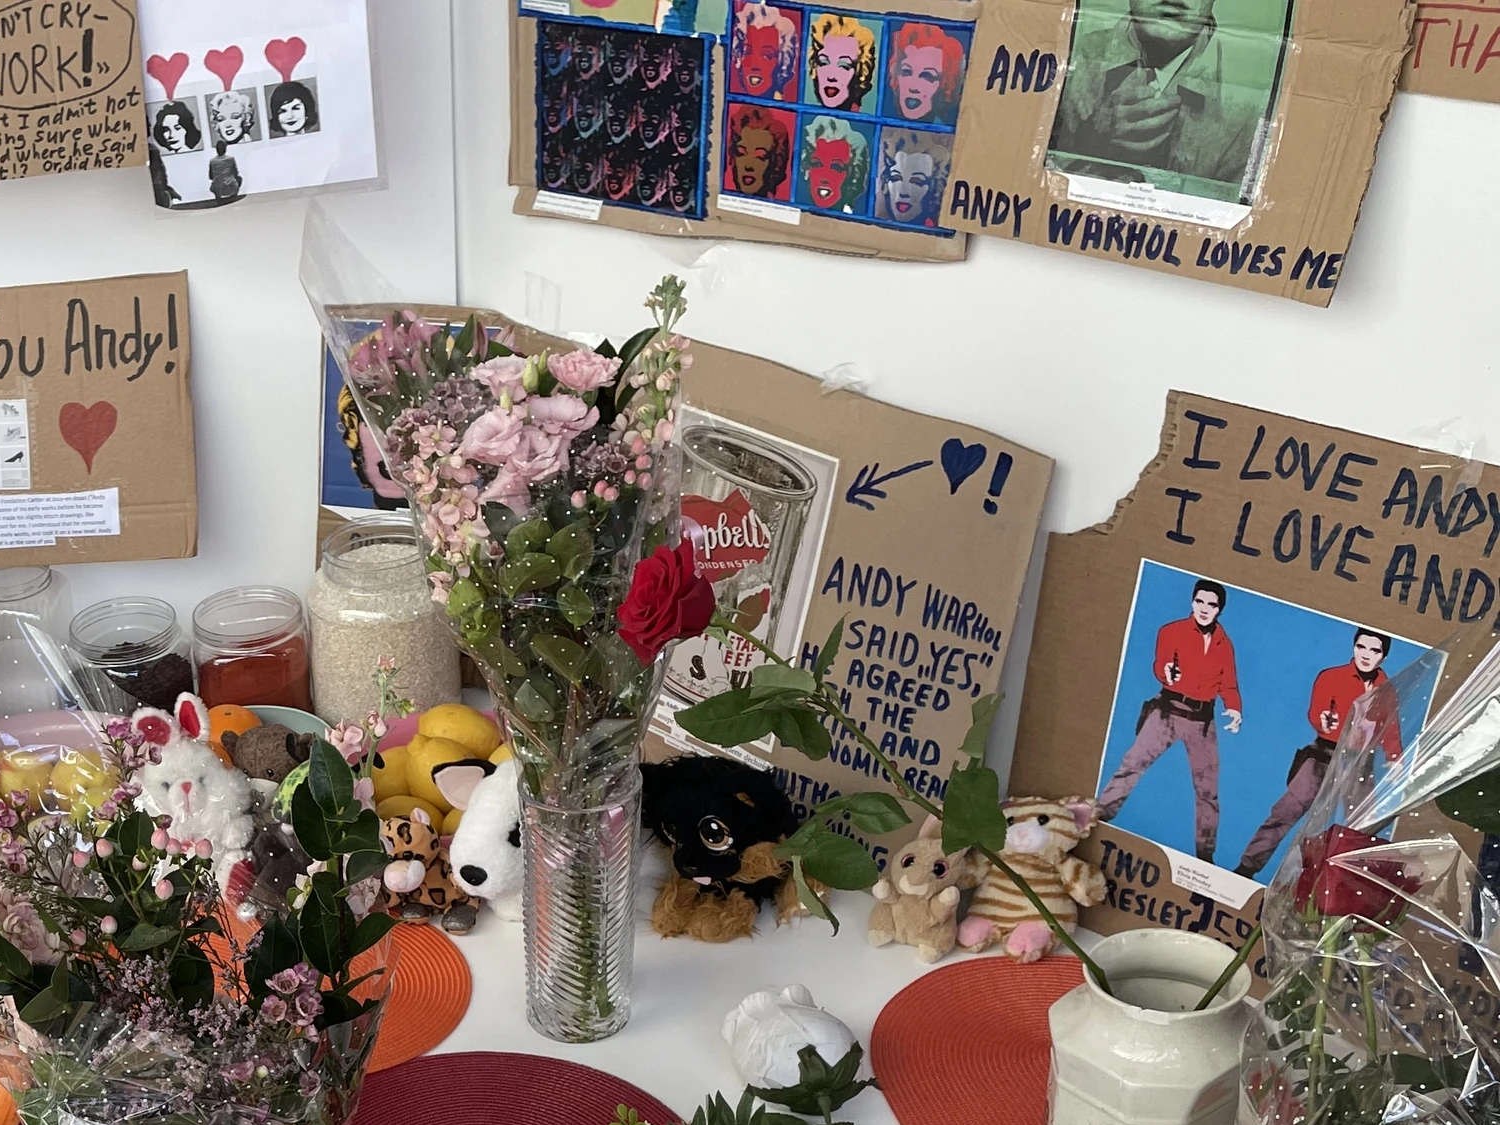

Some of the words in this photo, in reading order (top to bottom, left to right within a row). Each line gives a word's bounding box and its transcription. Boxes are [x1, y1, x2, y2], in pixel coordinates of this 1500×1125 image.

[987, 44, 1059, 95] AND
[17, 114, 30, 130] I
[37, 99, 97, 128] admit
[106, 85, 141, 113] not
[35, 127, 83, 143] sure
[88, 115, 131, 138] when
[16, 143, 66, 163] where
[73, 141, 94, 160] he
[99, 133, 138, 153] said
[93, 152, 125, 169] he?
[949, 180, 1031, 237] ANDY
[1048, 203, 1181, 267] WARHOL
[1196, 238, 1287, 276] LOVES
[1290, 246, 1343, 290] ME
[64, 293, 179, 382] Andy!
[1183, 409, 1228, 471] I
[1239, 424, 1378, 502] LOVE
[1382, 467, 1500, 558] ANDY
[1165, 487, 1202, 545] I
[1232, 501, 1375, 583] LOVE
[1382, 544, 1500, 626] AND
[822, 556, 917, 617] ANDY
[922, 583, 1002, 651] WARHOL
[845, 619, 919, 668] SAID
[847, 659, 950, 711] AGREED
[867, 697, 918, 734] THE
[880, 731, 941, 766] AND
[1100, 839, 1161, 888] TWO
[1104, 878, 1192, 930] RESLEY
